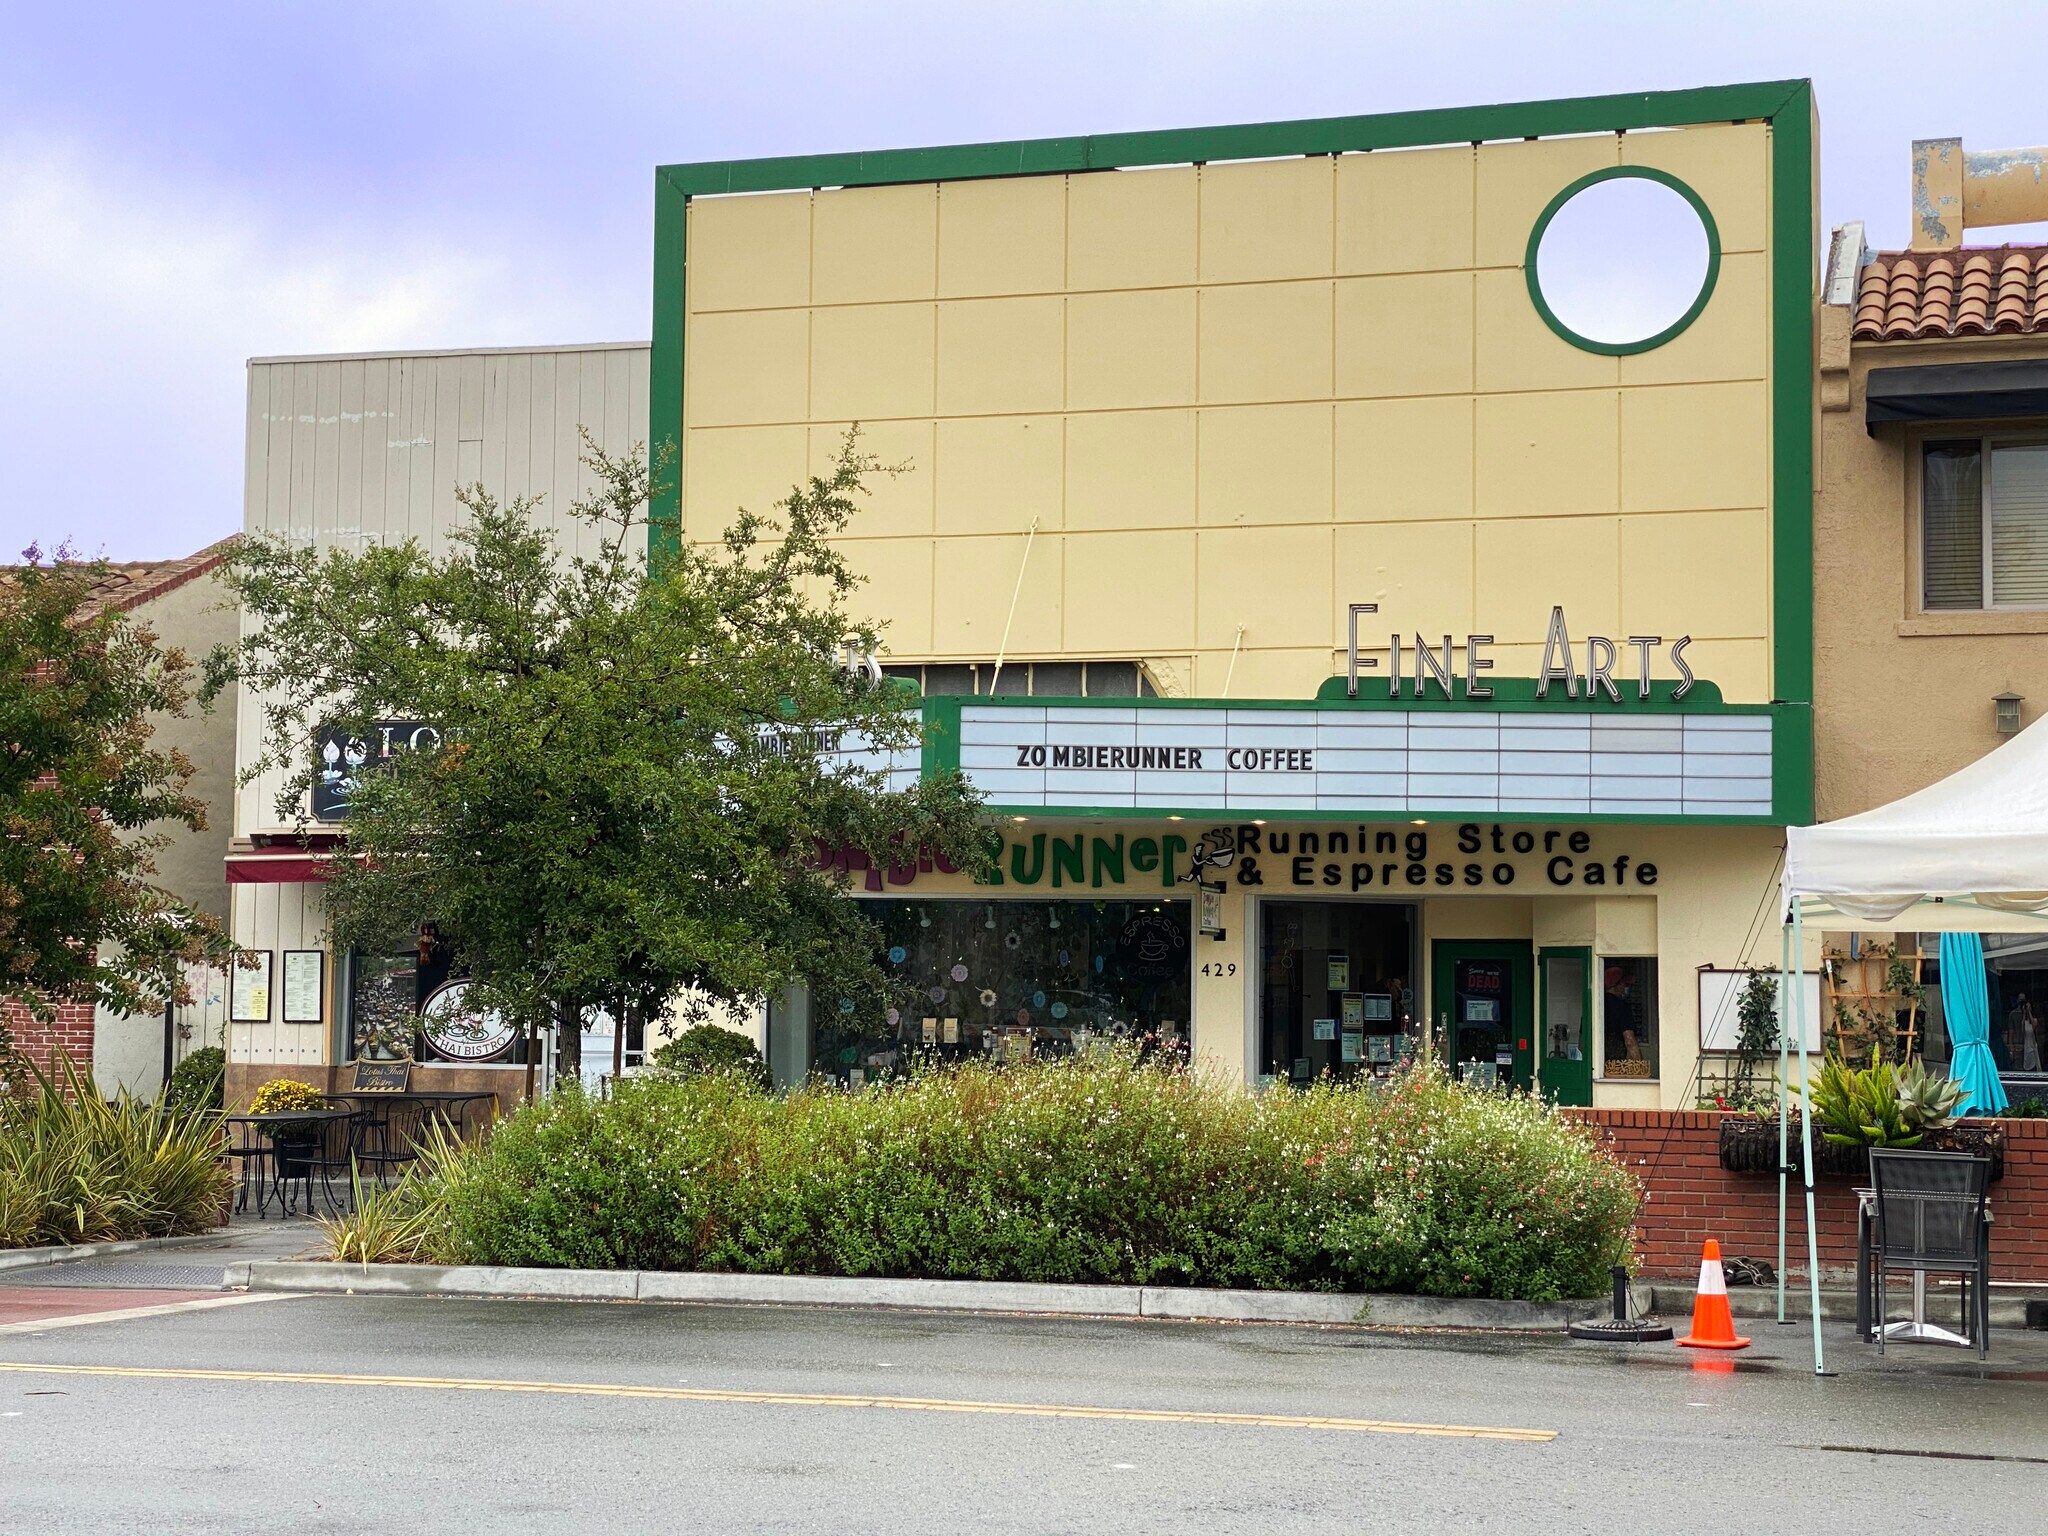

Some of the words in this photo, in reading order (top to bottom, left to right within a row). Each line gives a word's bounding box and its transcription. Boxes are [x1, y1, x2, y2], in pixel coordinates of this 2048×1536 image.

[1227, 748, 1312, 771] COFFEE
[1237, 825, 1427, 860] Running
[1457, 824, 1591, 854] Store
[1237, 859, 1264, 885] &
[1293, 857, 1515, 892] Espresso
[1547, 855, 1659, 885] Cafe
[1120, 916, 1185, 948] ESPRESSO
[1201, 963, 1236, 976] 429
[1468, 975, 1500, 989] DEAD
[434, 1036, 461, 1056] THAI
[464, 1036, 506, 1056] BISTRO
